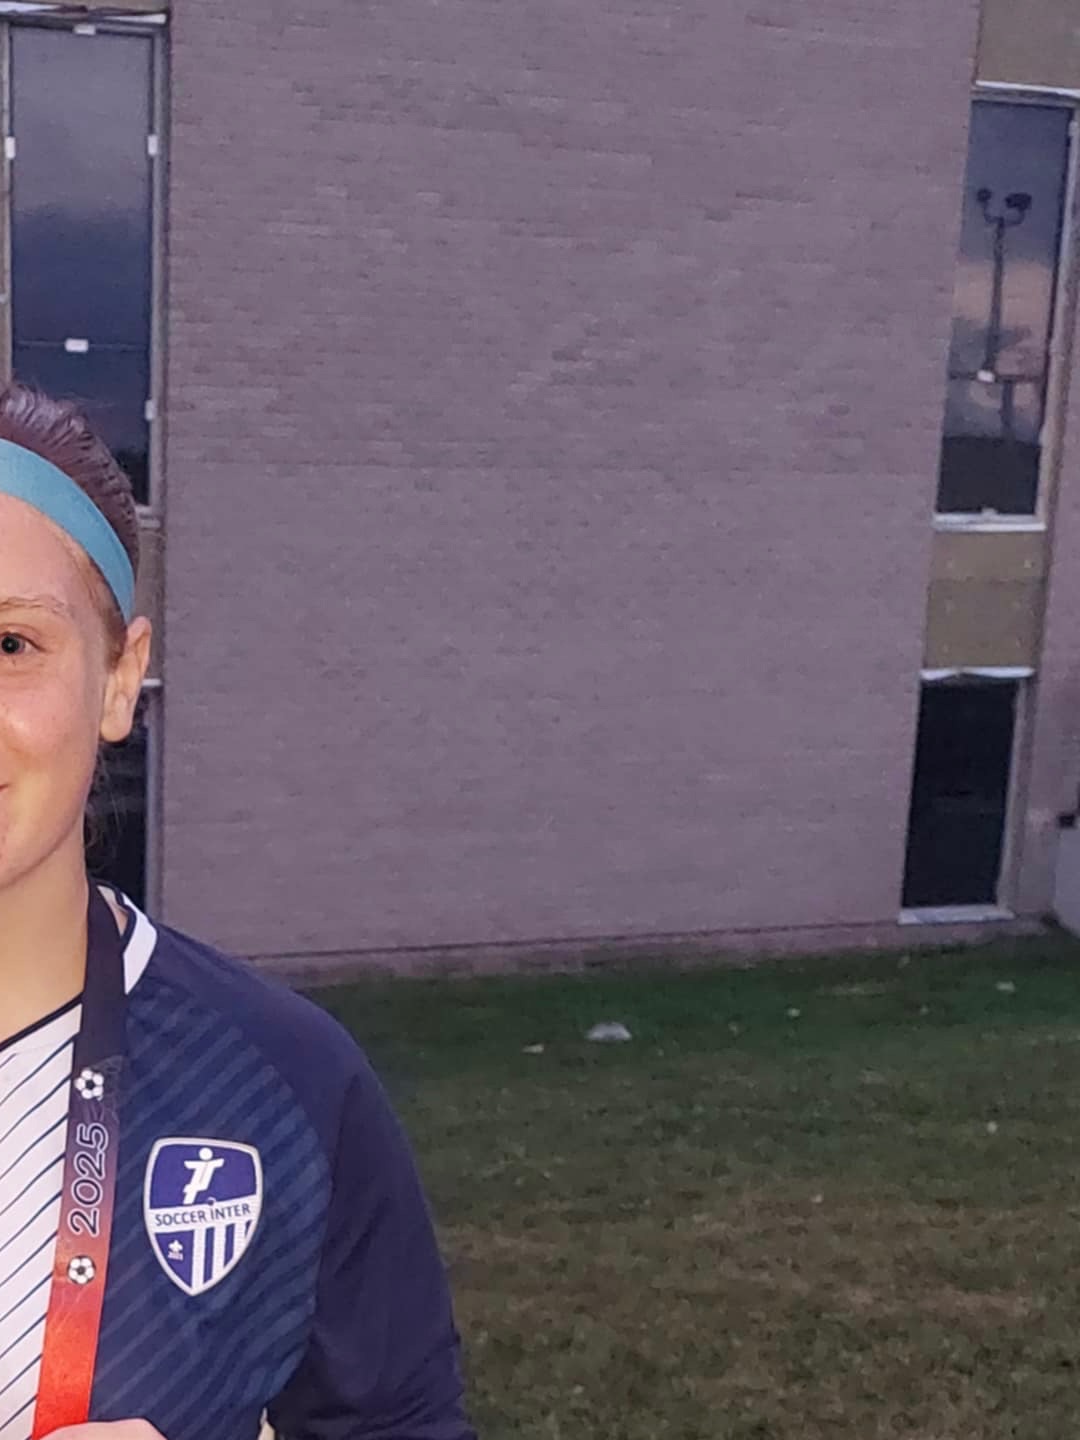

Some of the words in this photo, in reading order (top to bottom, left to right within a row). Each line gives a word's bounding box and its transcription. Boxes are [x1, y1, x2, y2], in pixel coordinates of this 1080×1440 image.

[70, 1122, 108, 1236] 2025
[155, 1210, 206, 1226] SOCCER
[210, 1203, 251, 1220] INTER
